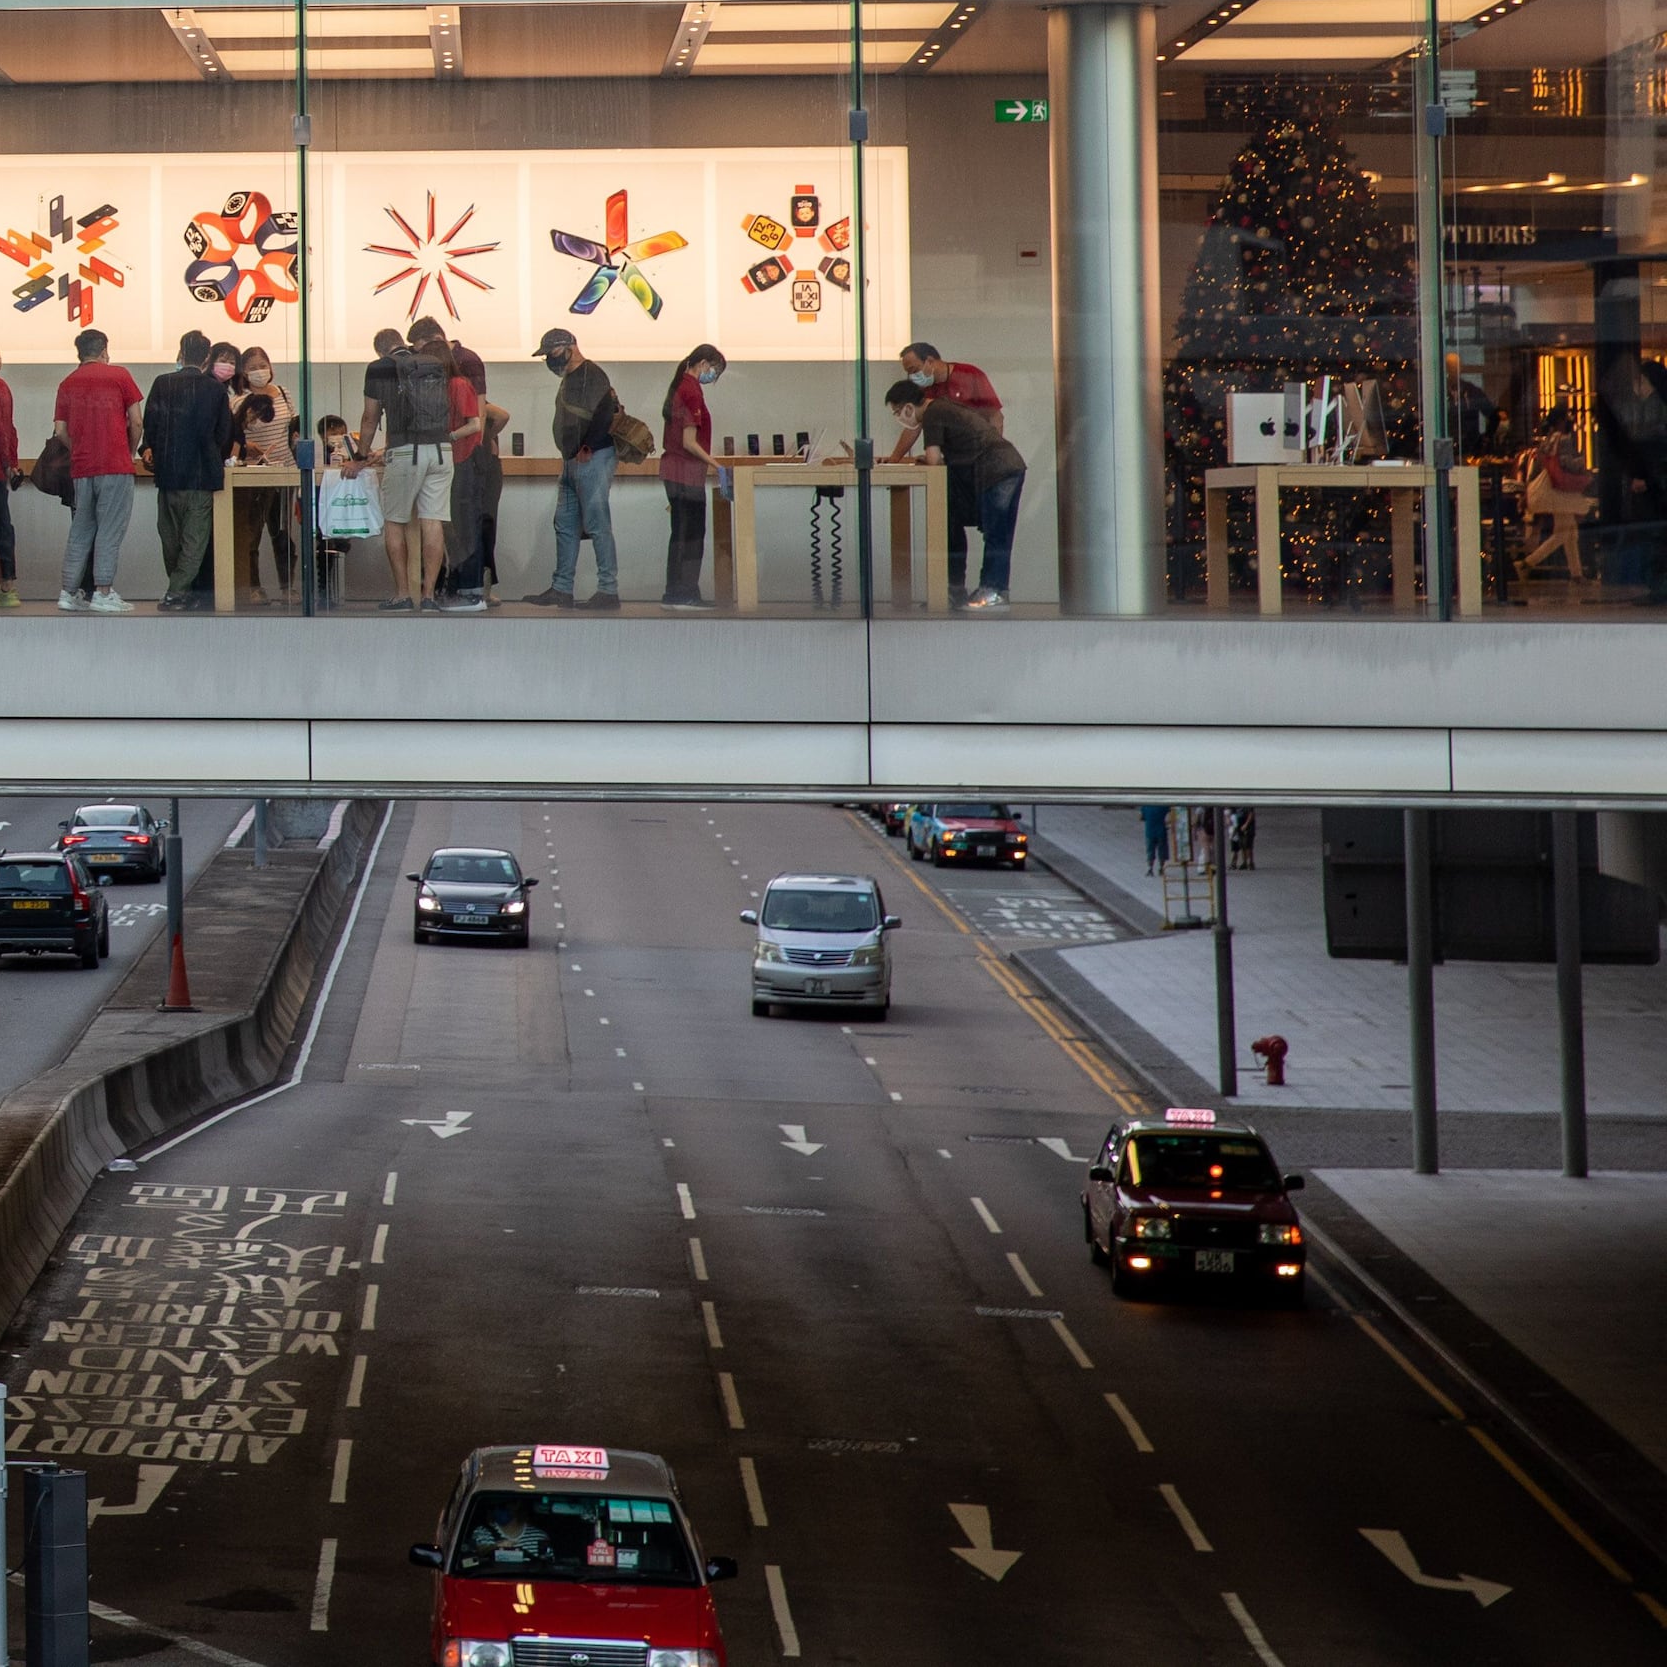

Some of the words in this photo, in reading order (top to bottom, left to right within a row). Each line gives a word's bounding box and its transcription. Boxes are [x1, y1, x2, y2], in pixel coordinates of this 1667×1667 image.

[66, 1300, 344, 1332] DISTRICT
[42, 1321, 341, 1357] WESTERN
[67, 1347, 279, 1376] AND
[23, 1370, 303, 1405] STATION
[4, 1396, 309, 1435] EXPRESS
[4, 1423, 289, 1465] AIRPORT
[541, 1449, 603, 1464] TAXI
